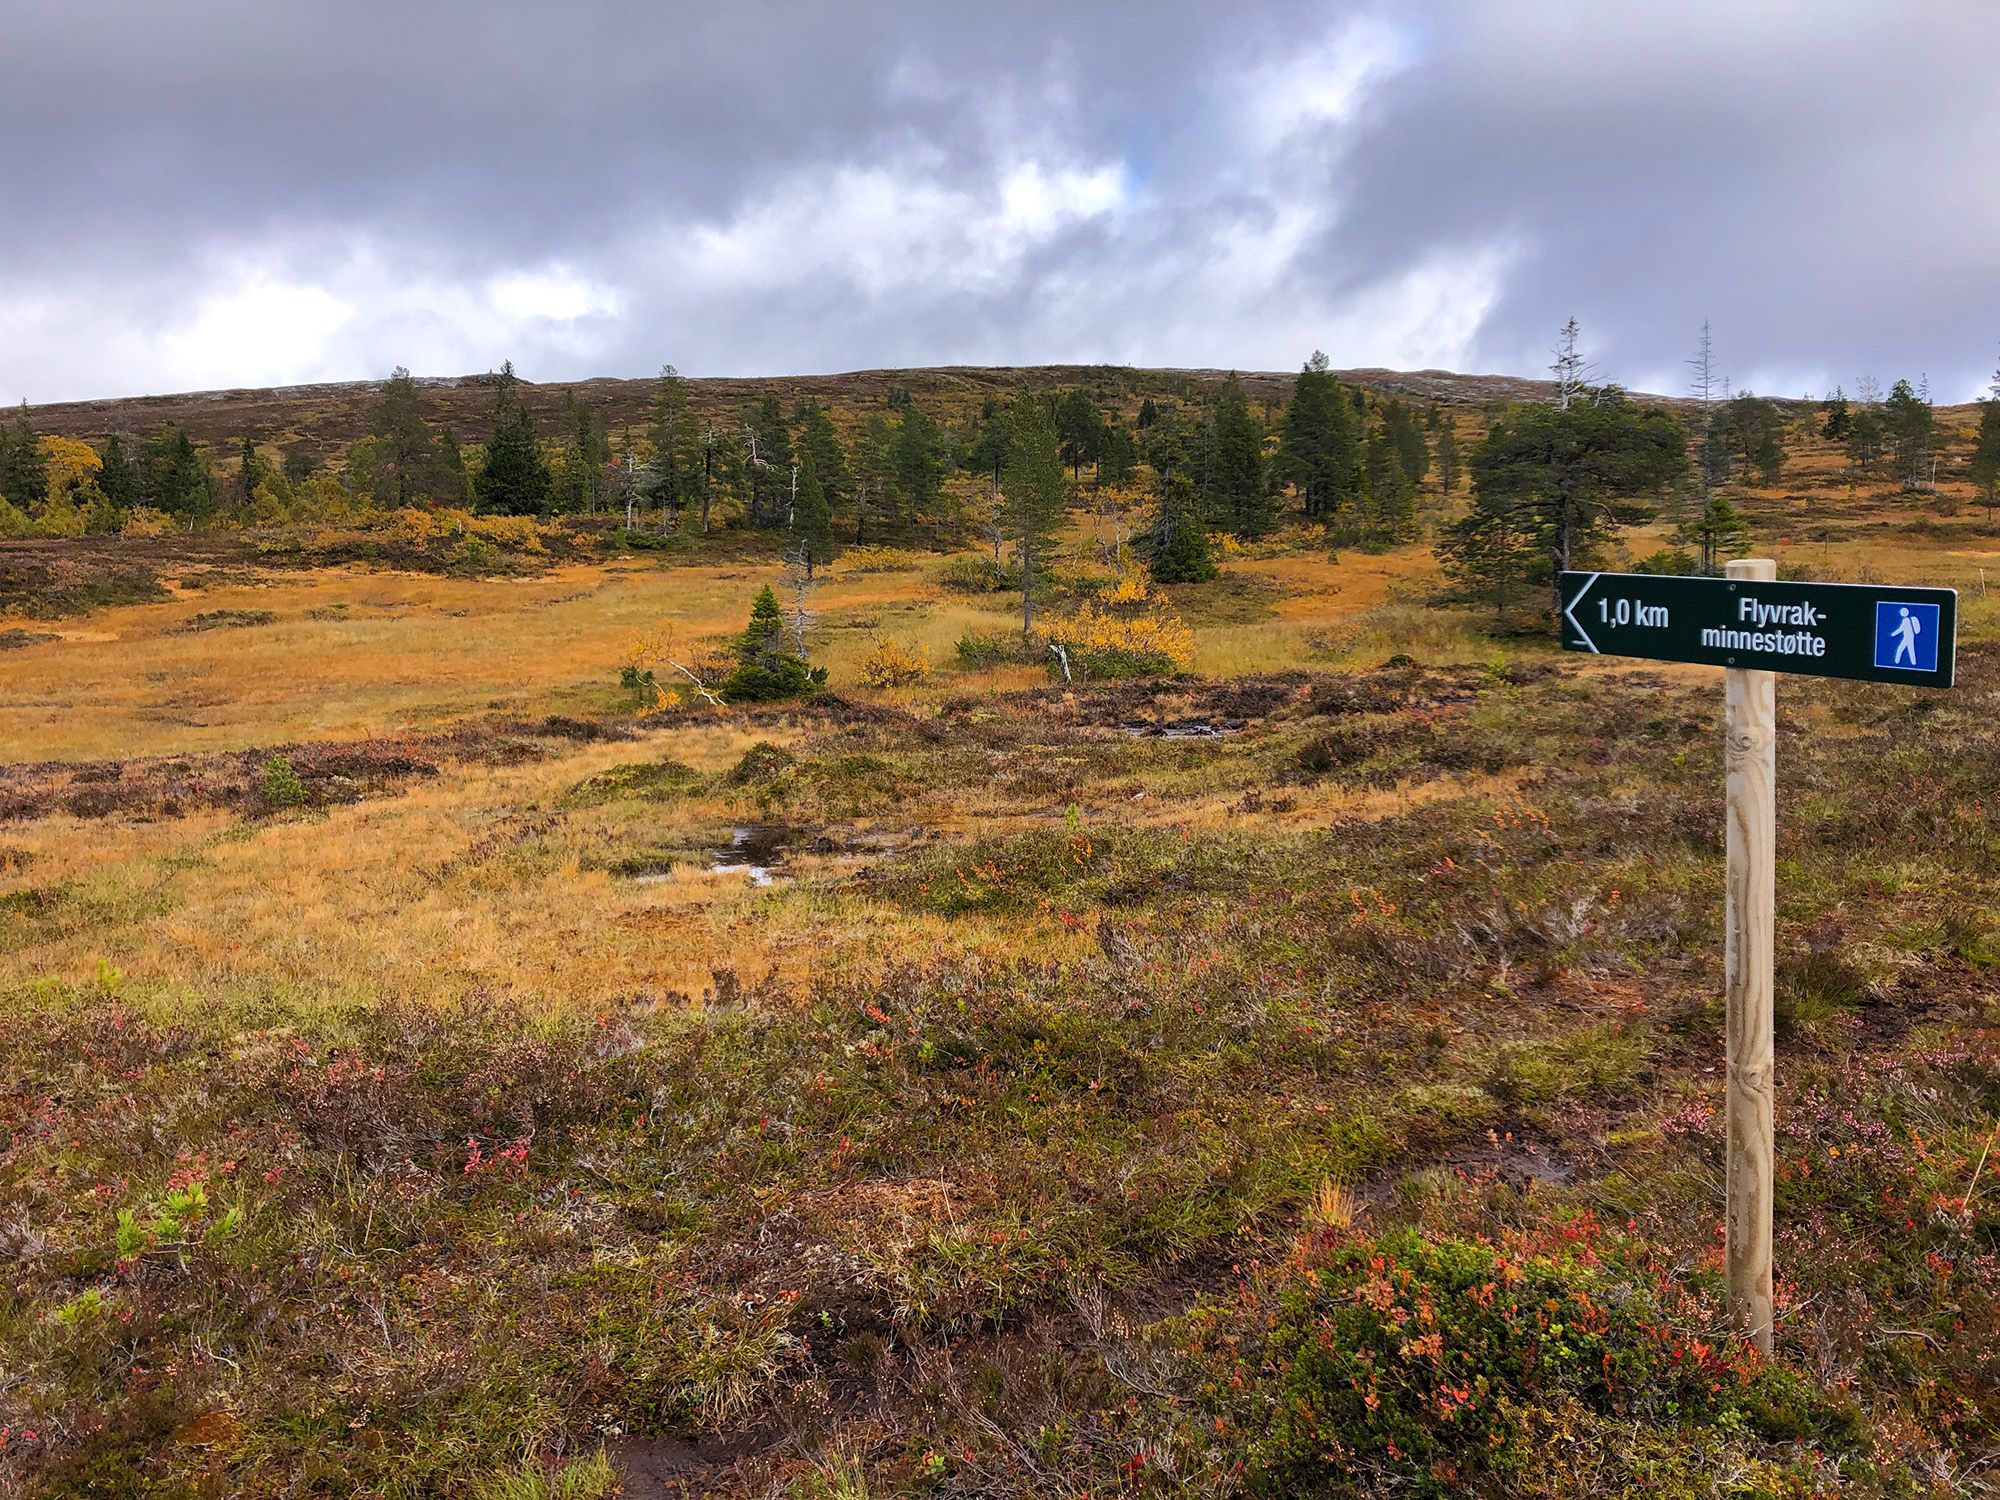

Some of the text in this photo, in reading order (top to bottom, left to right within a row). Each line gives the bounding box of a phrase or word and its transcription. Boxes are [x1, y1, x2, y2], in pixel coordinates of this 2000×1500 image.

[1598, 598, 1670, 629] 1,0 km
[1738, 597, 1827, 628] Flyvrak-
[1701, 625, 1826, 658] minnestøtte
